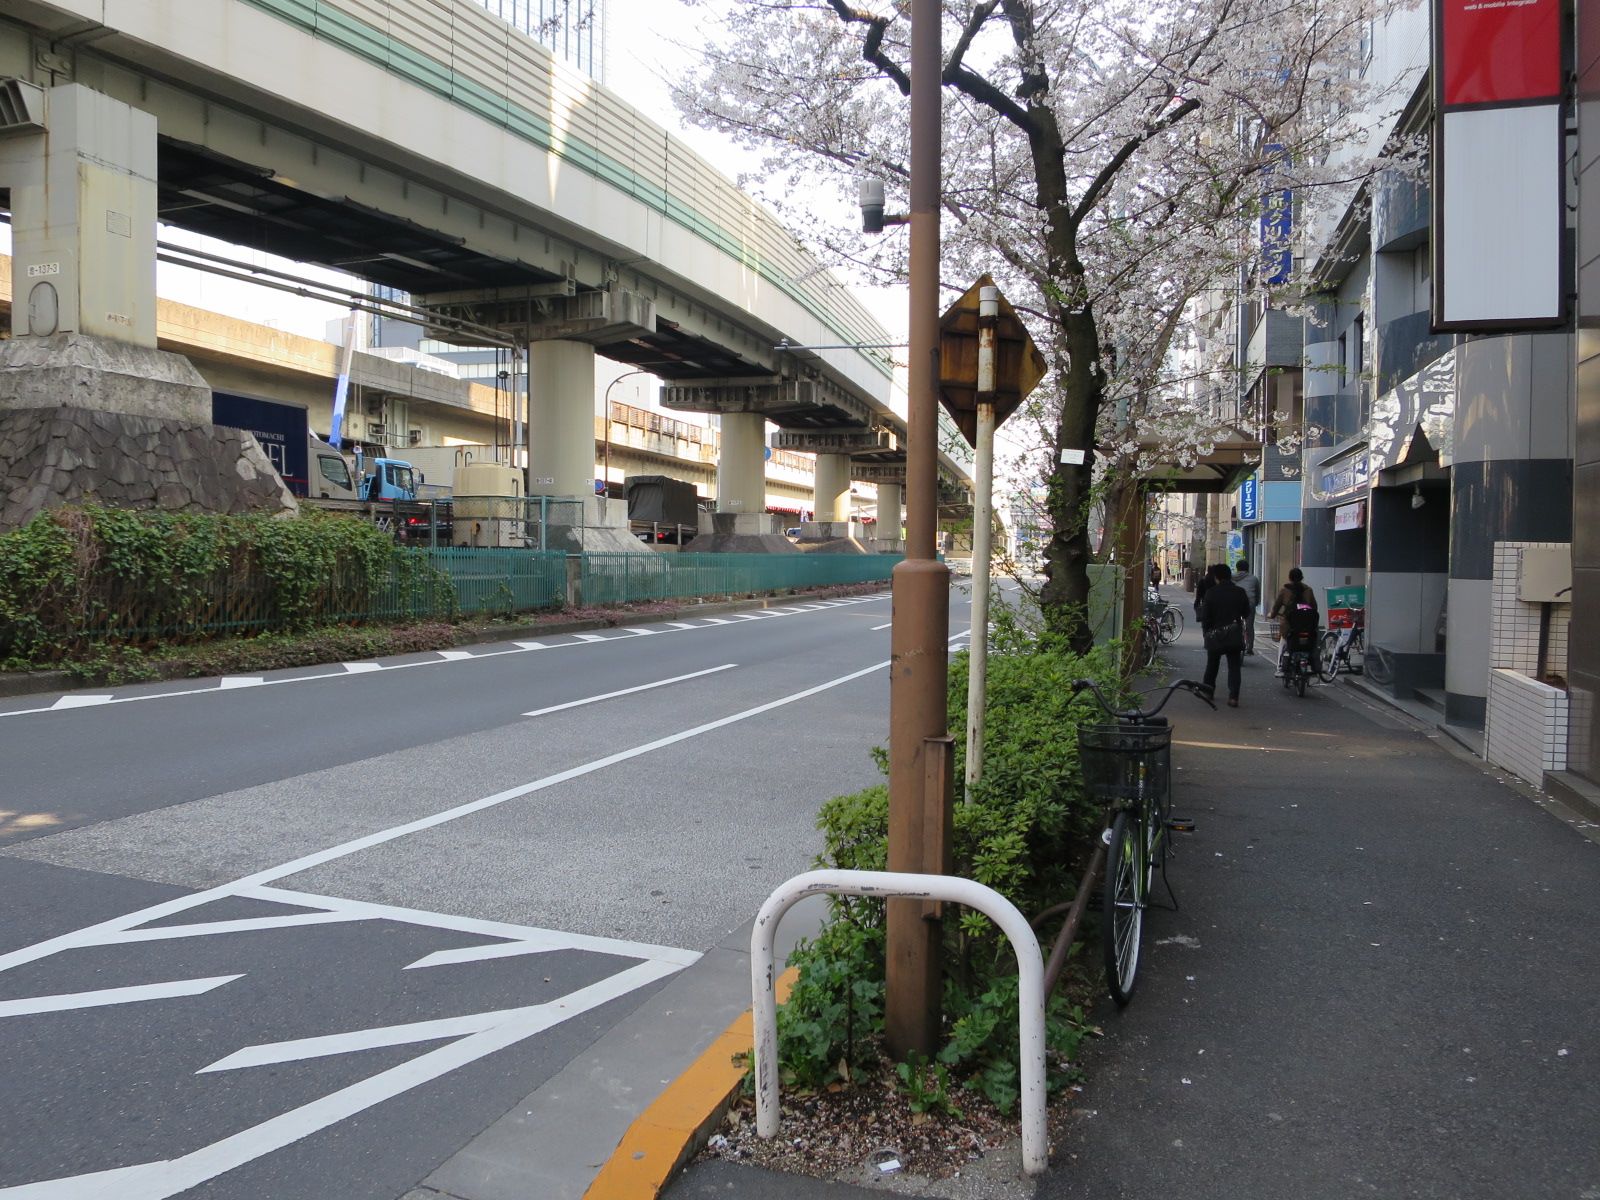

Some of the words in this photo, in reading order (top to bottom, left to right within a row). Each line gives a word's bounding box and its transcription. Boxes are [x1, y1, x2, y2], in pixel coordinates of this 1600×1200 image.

[1244, 480, 1255, 519] クリーニング
